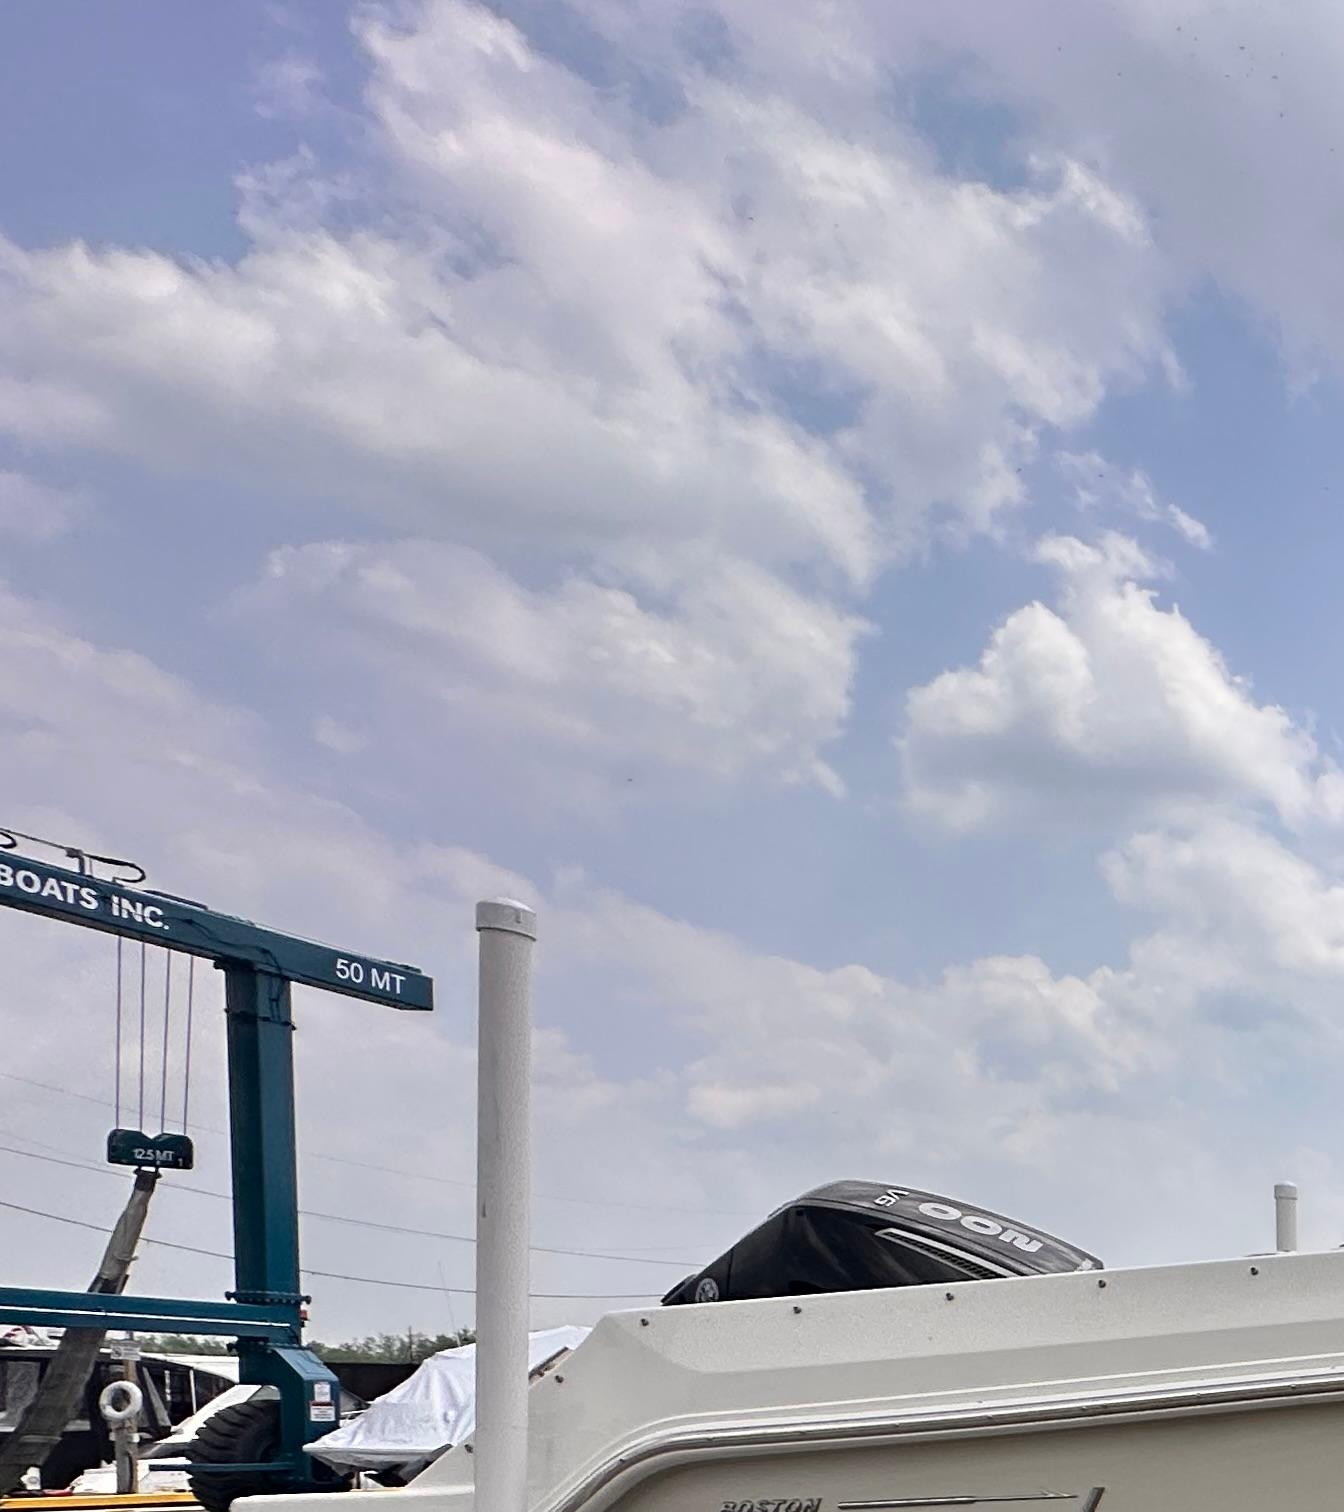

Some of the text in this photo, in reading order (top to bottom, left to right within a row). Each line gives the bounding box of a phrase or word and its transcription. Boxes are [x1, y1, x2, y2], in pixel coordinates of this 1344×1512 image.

[0, 863, 170, 930] BOATS INC.
[336, 958, 407, 994] 50 MT
[874, 1189, 910, 1207] V6
[918, 1202, 1044, 1252] 200
